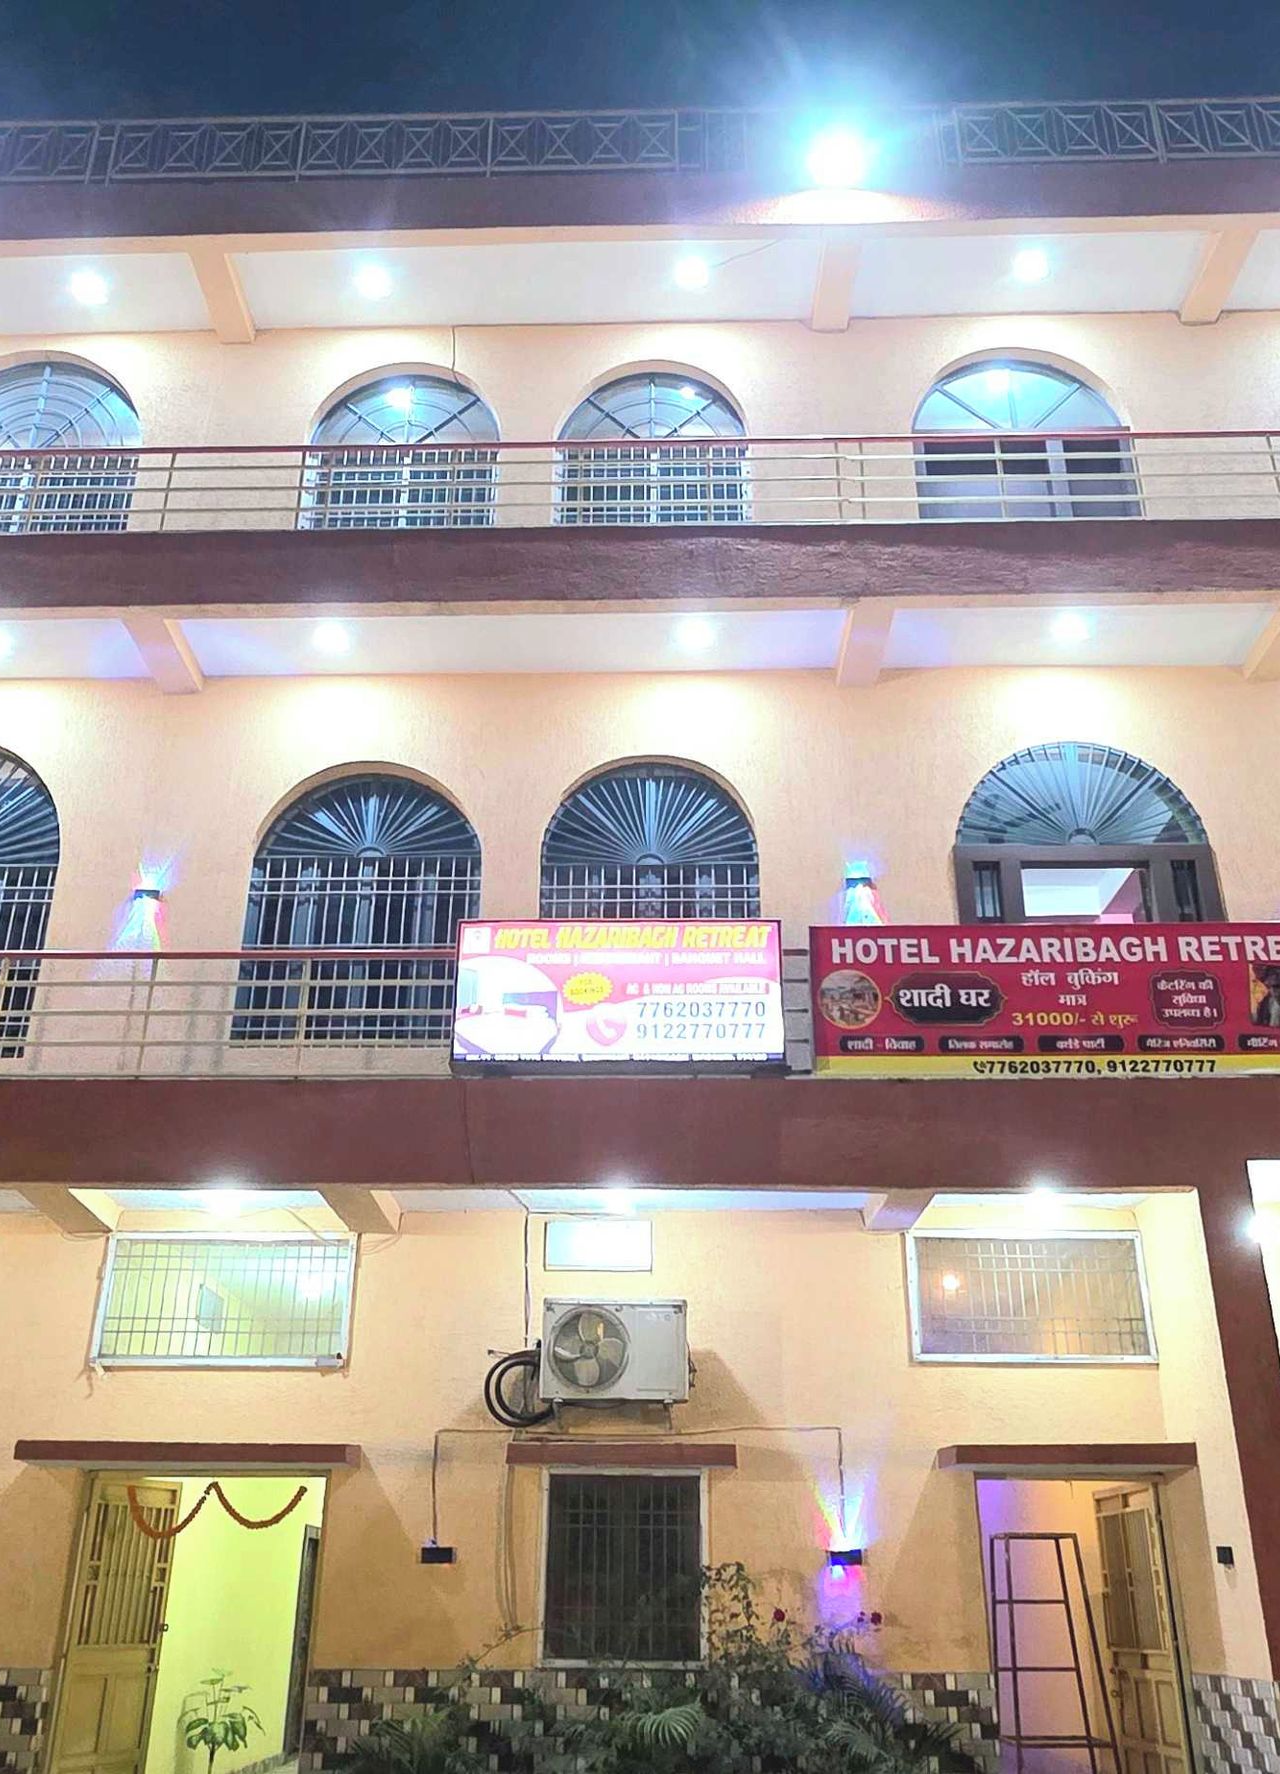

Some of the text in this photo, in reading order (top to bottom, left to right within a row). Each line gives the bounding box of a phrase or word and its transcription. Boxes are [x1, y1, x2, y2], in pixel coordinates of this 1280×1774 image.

[493, 925, 771, 950] HOTEL HAZARIBAGH RETREAT
[831, 937, 940, 965] HOTEL
[949, 935, 1169, 965] HAZARIBAGH
[1020, 967, 1120, 991] हॉल बुकिंग
[898, 983, 991, 1008] शादी घर
[636, 1001, 766, 1018] 7762037770
[1011, 1012, 1086, 1027] 31000/-
[636, 1023, 766, 1039] 9122770777
[1107, 1059, 1217, 1073] 9122770777
